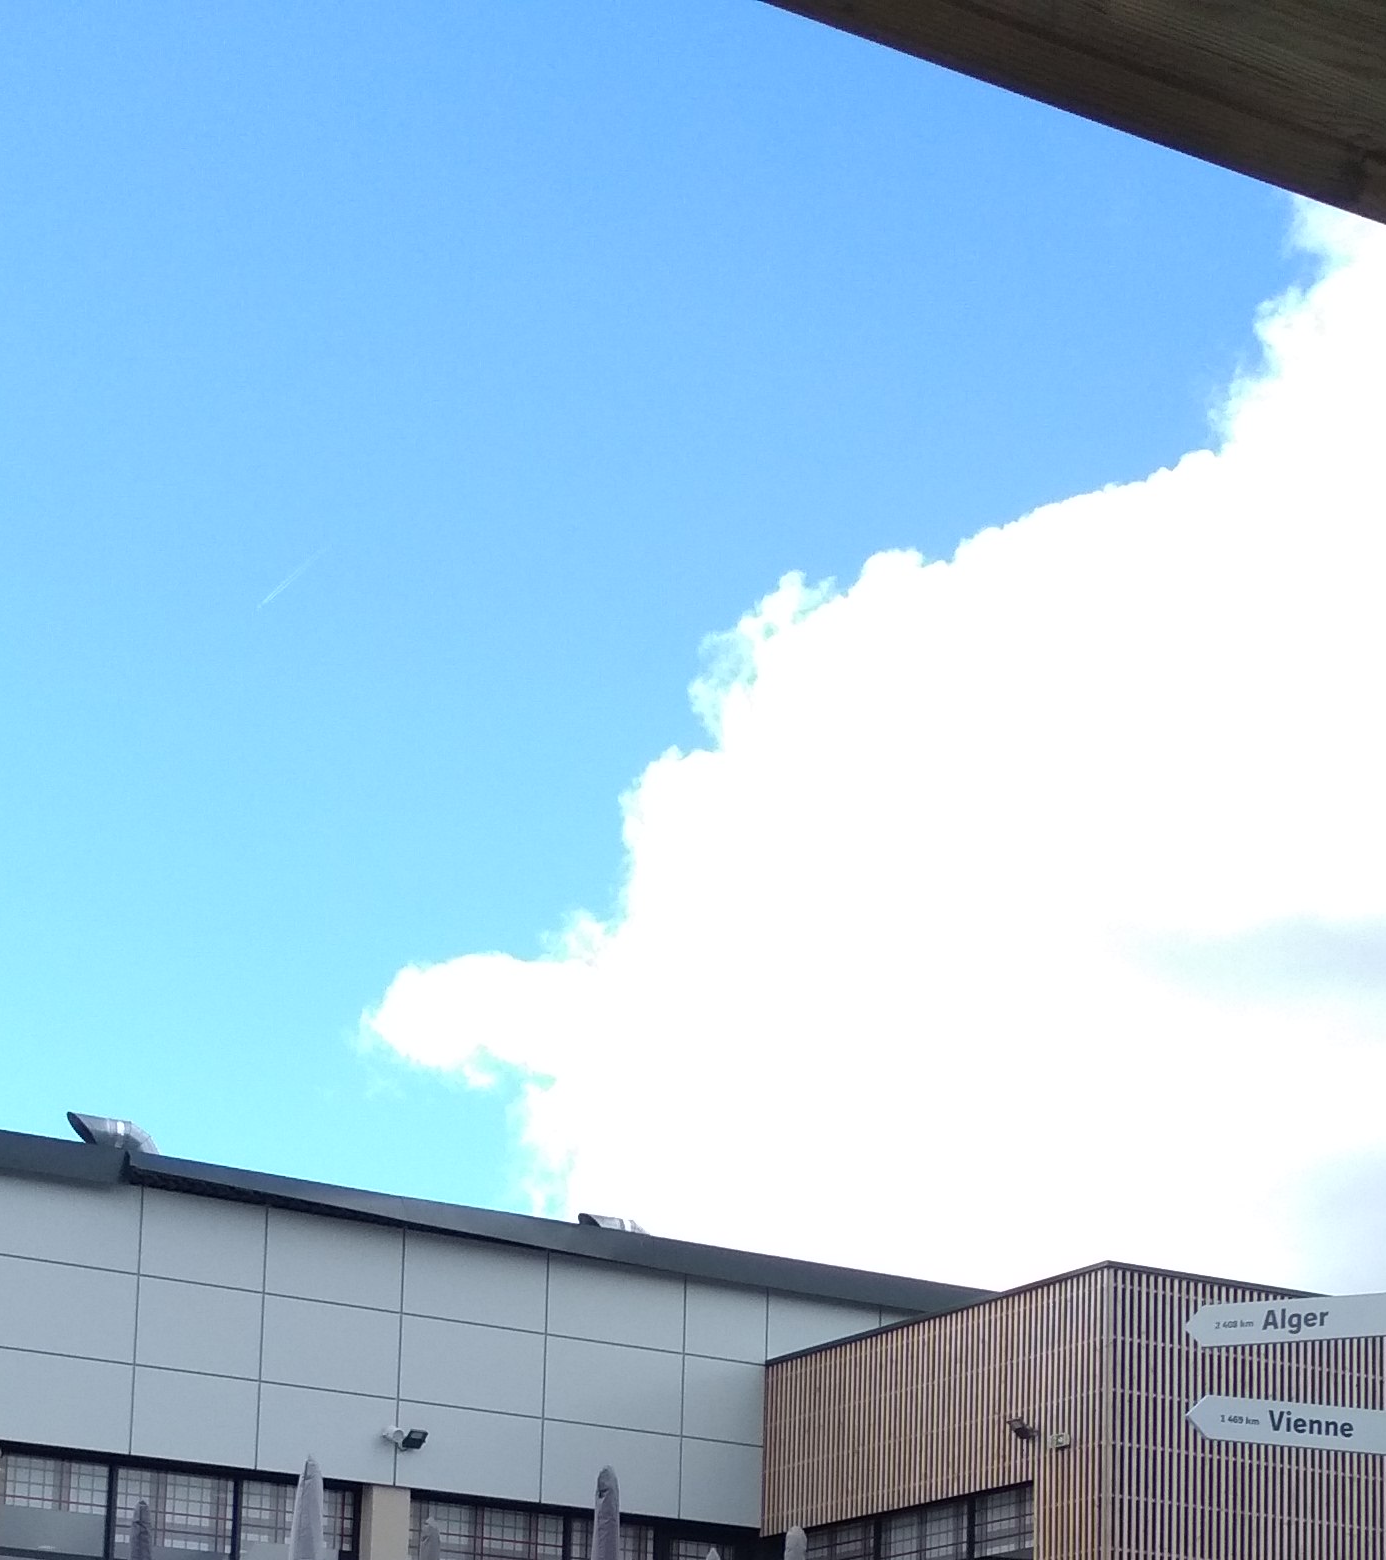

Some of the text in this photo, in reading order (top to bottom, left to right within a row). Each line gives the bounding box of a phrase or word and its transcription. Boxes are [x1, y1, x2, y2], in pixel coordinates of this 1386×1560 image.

[1240, 1320, 1255, 1328] km
[1262, 1308, 1329, 1334] Alger
[1246, 1416, 1260, 1425] km
[1268, 1410, 1355, 1438] Vienne
